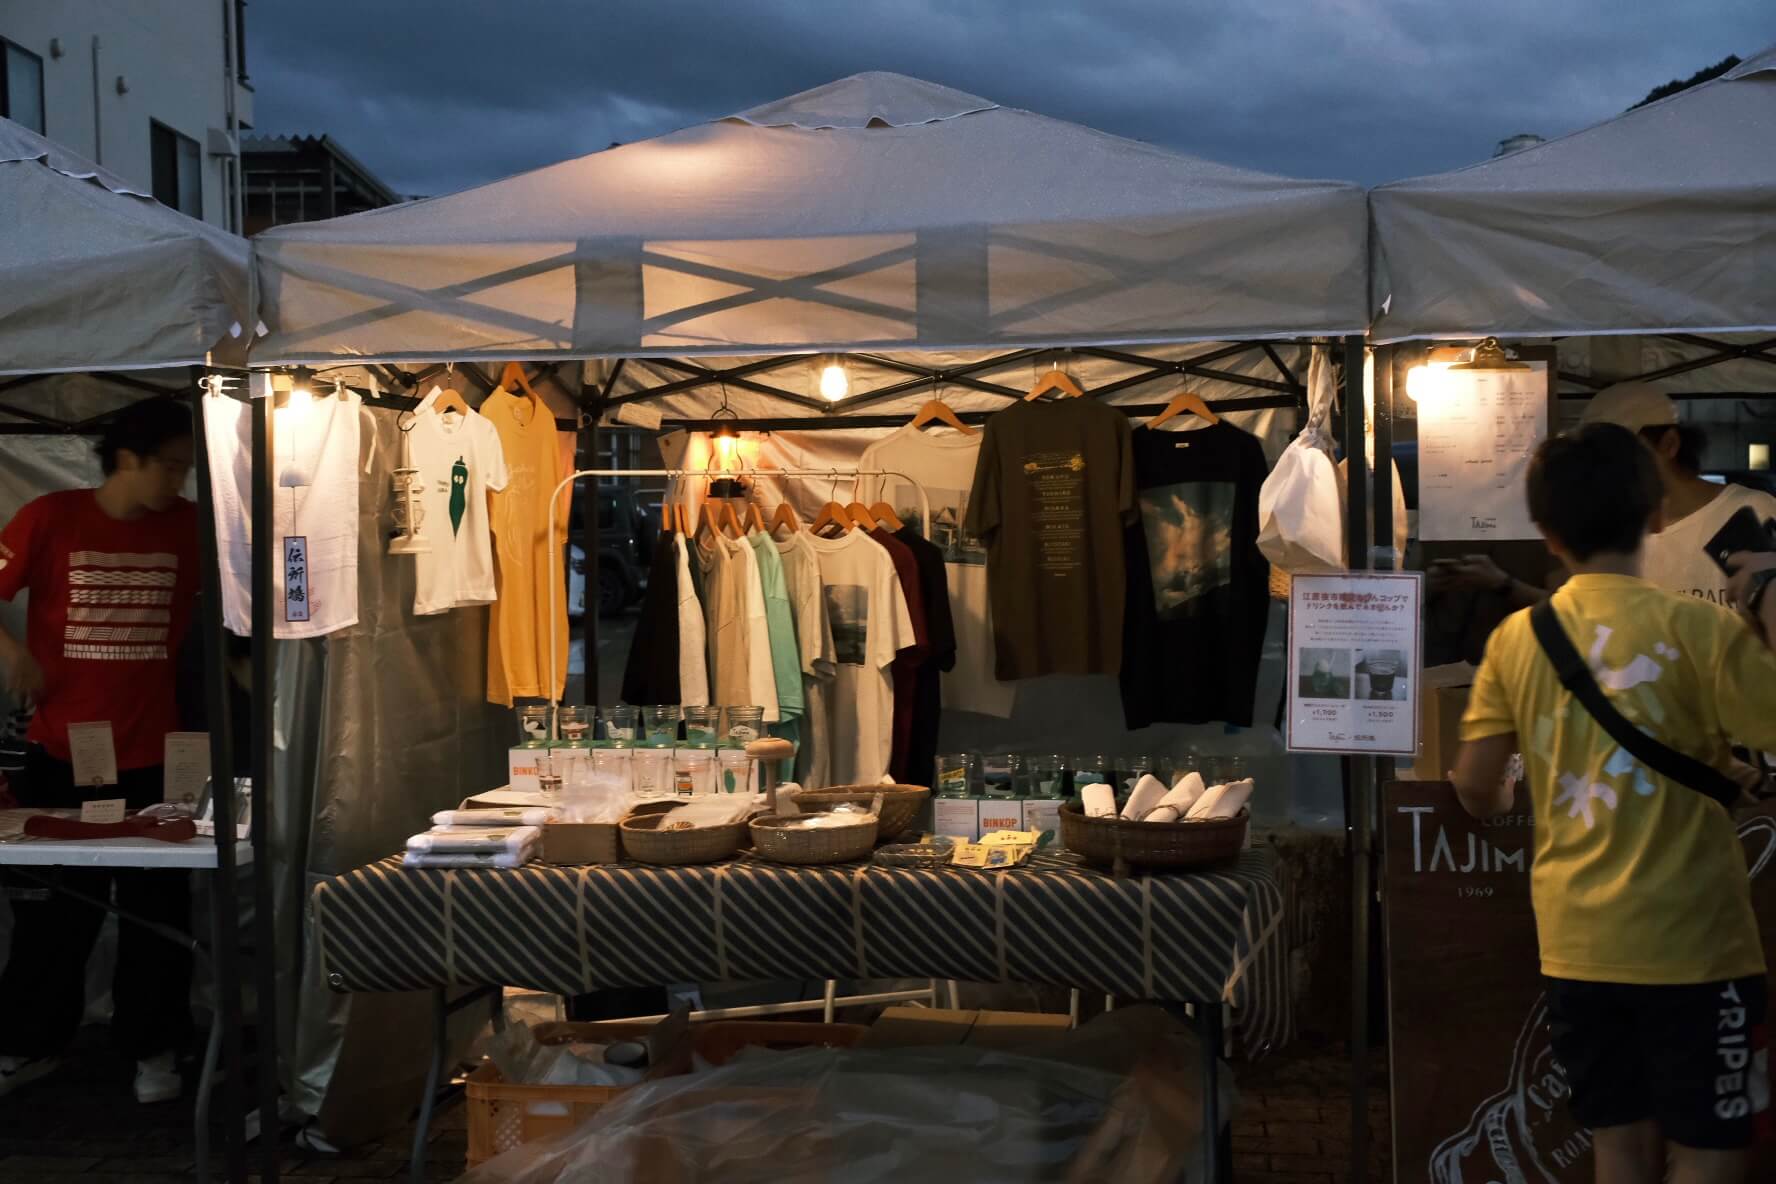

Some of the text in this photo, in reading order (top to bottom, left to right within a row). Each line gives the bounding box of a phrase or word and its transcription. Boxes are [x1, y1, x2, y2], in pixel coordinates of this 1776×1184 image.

[513, 767, 540, 776] BINKO
[983, 818, 1018, 828] BINKOP
[1397, 806, 1532, 873] TAJIM
[1458, 887, 1494, 897] 1969
